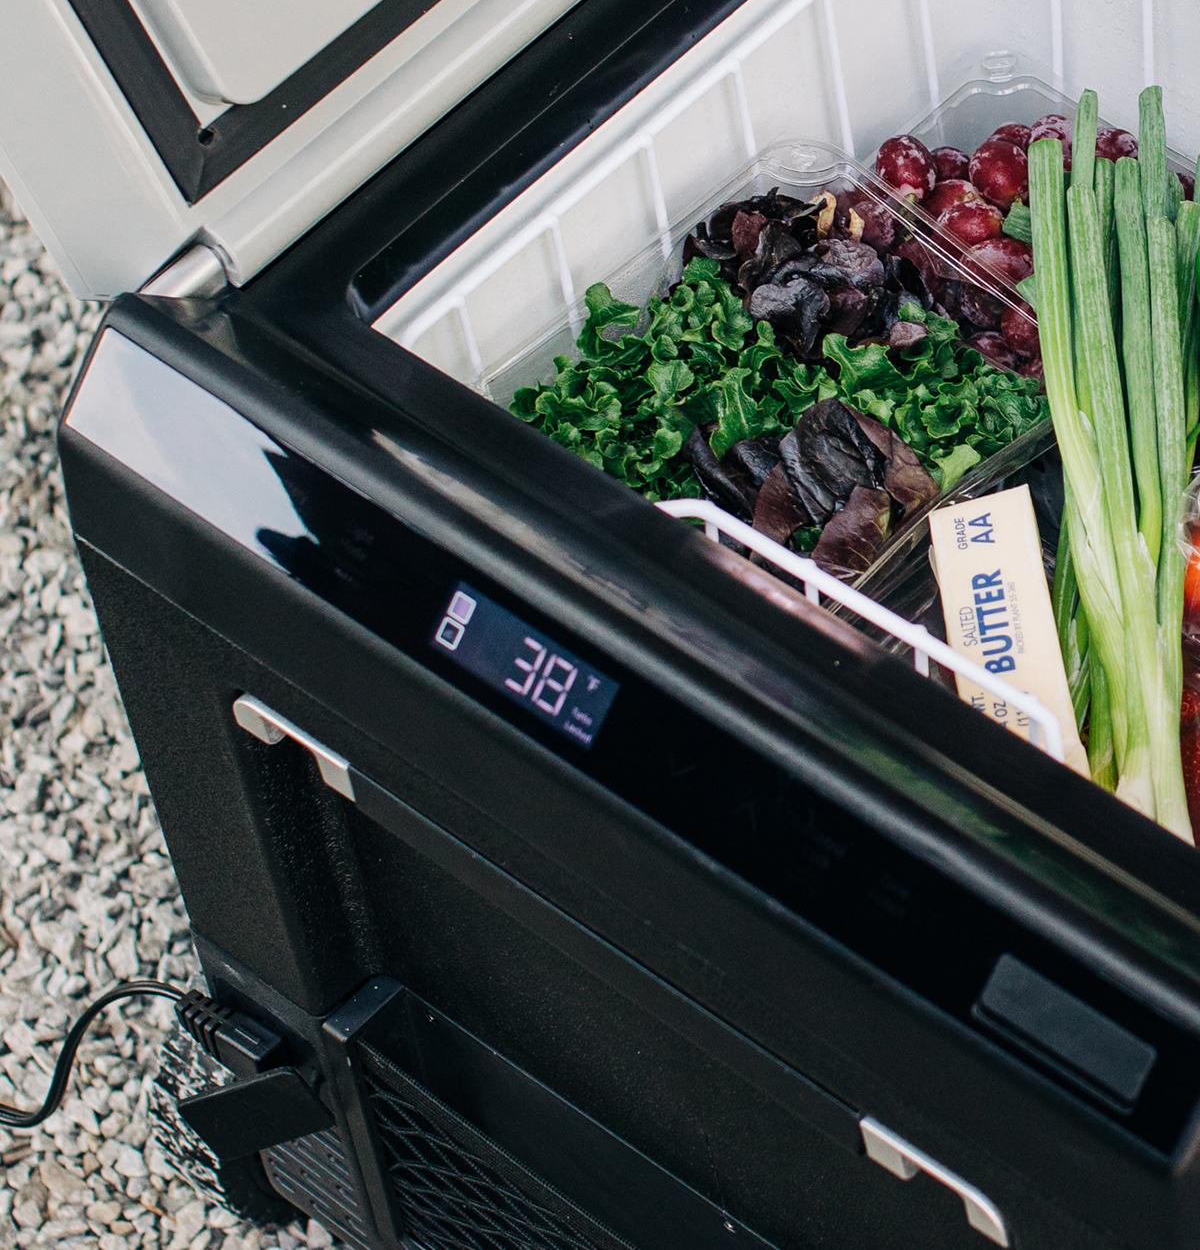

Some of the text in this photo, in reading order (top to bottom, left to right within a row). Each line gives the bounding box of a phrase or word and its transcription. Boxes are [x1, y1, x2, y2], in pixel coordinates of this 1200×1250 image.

[953, 517, 968, 550] GRADE
[968, 512, 996, 543] AA
[959, 606, 979, 647] SALTED
[972, 568, 1016, 674] BUTTER
[504, 636, 578, 716] 38
